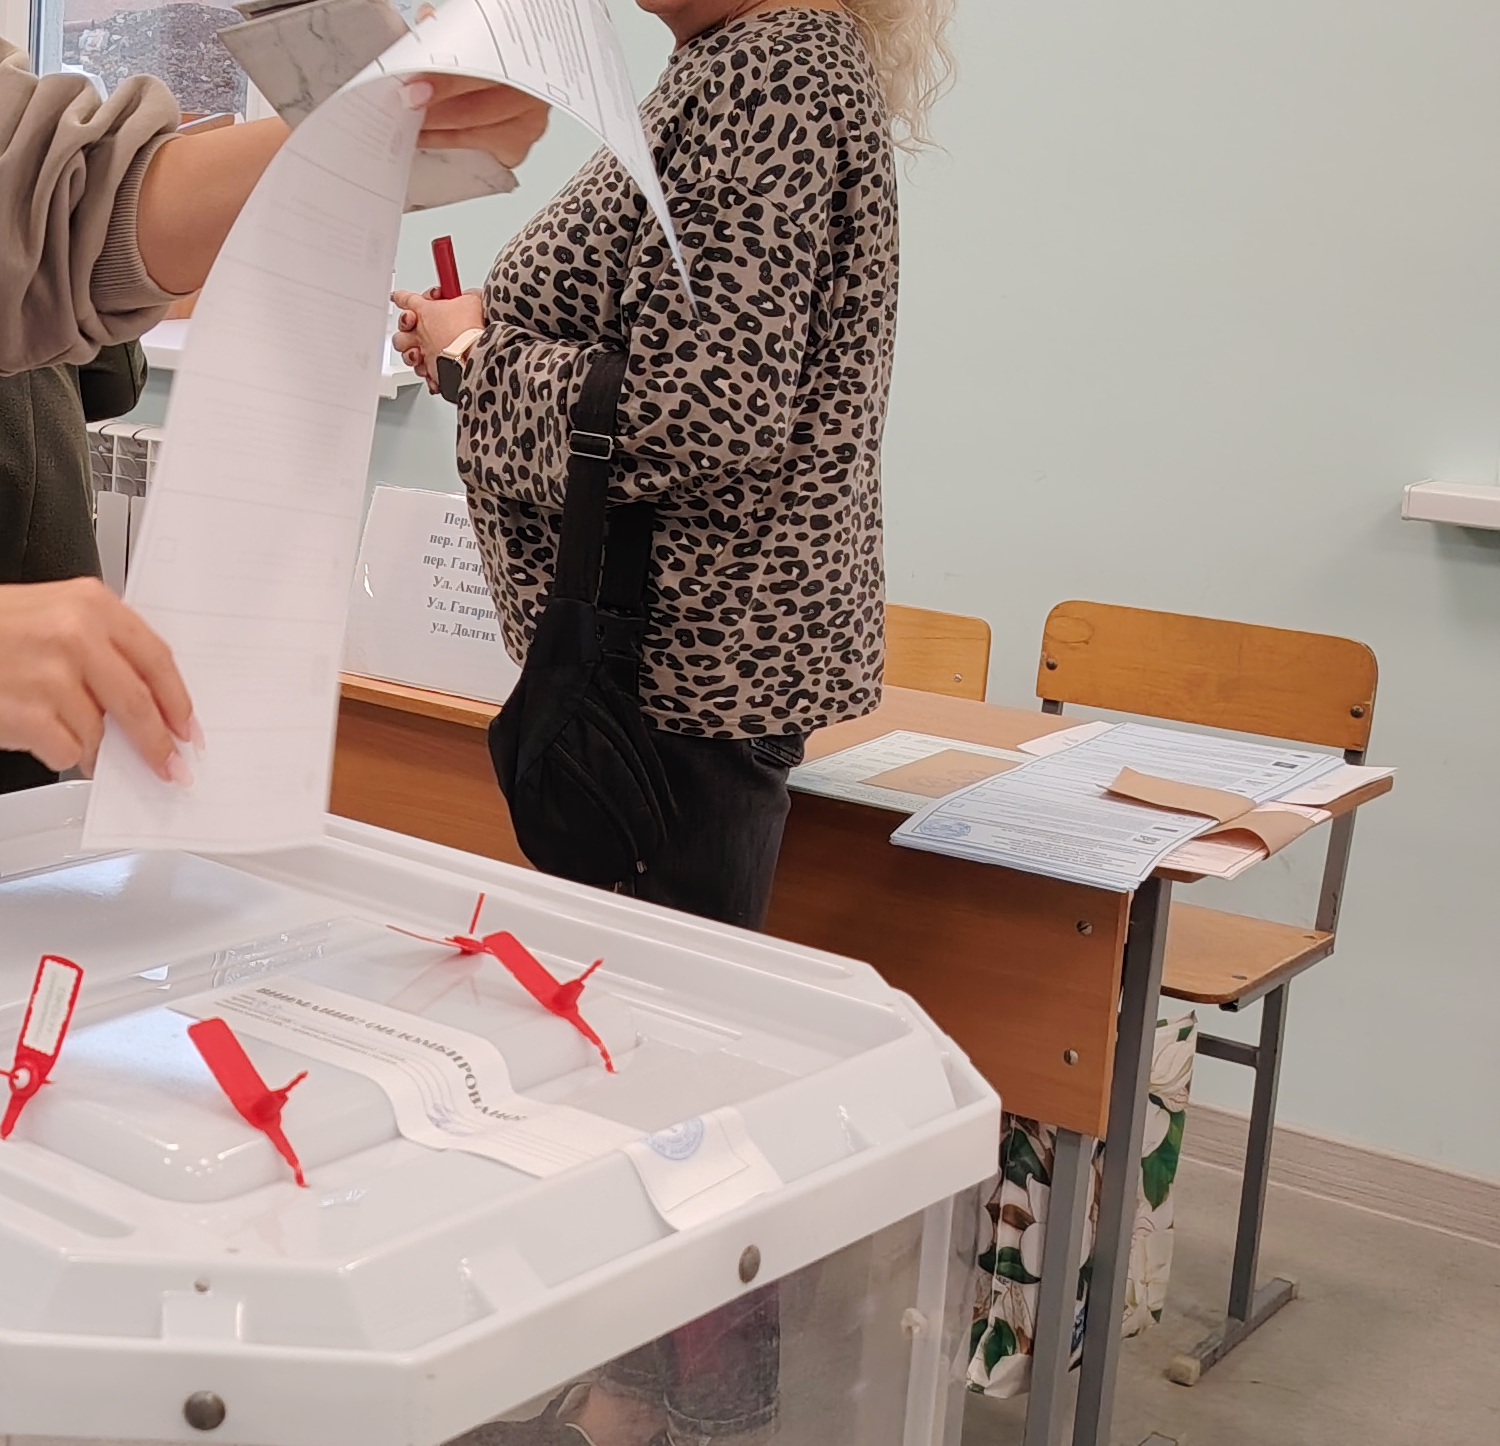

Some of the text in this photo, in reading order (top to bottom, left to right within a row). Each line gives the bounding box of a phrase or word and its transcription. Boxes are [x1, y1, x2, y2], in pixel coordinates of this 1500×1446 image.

[444, 512, 471, 529] Пер.
[430, 534, 454, 548] пер.
[423, 555, 448, 569] пер.
[432, 575, 453, 590] Ул.
[427, 596, 446, 611] Ул.
[430, 621, 497, 642] ул. Долгих
